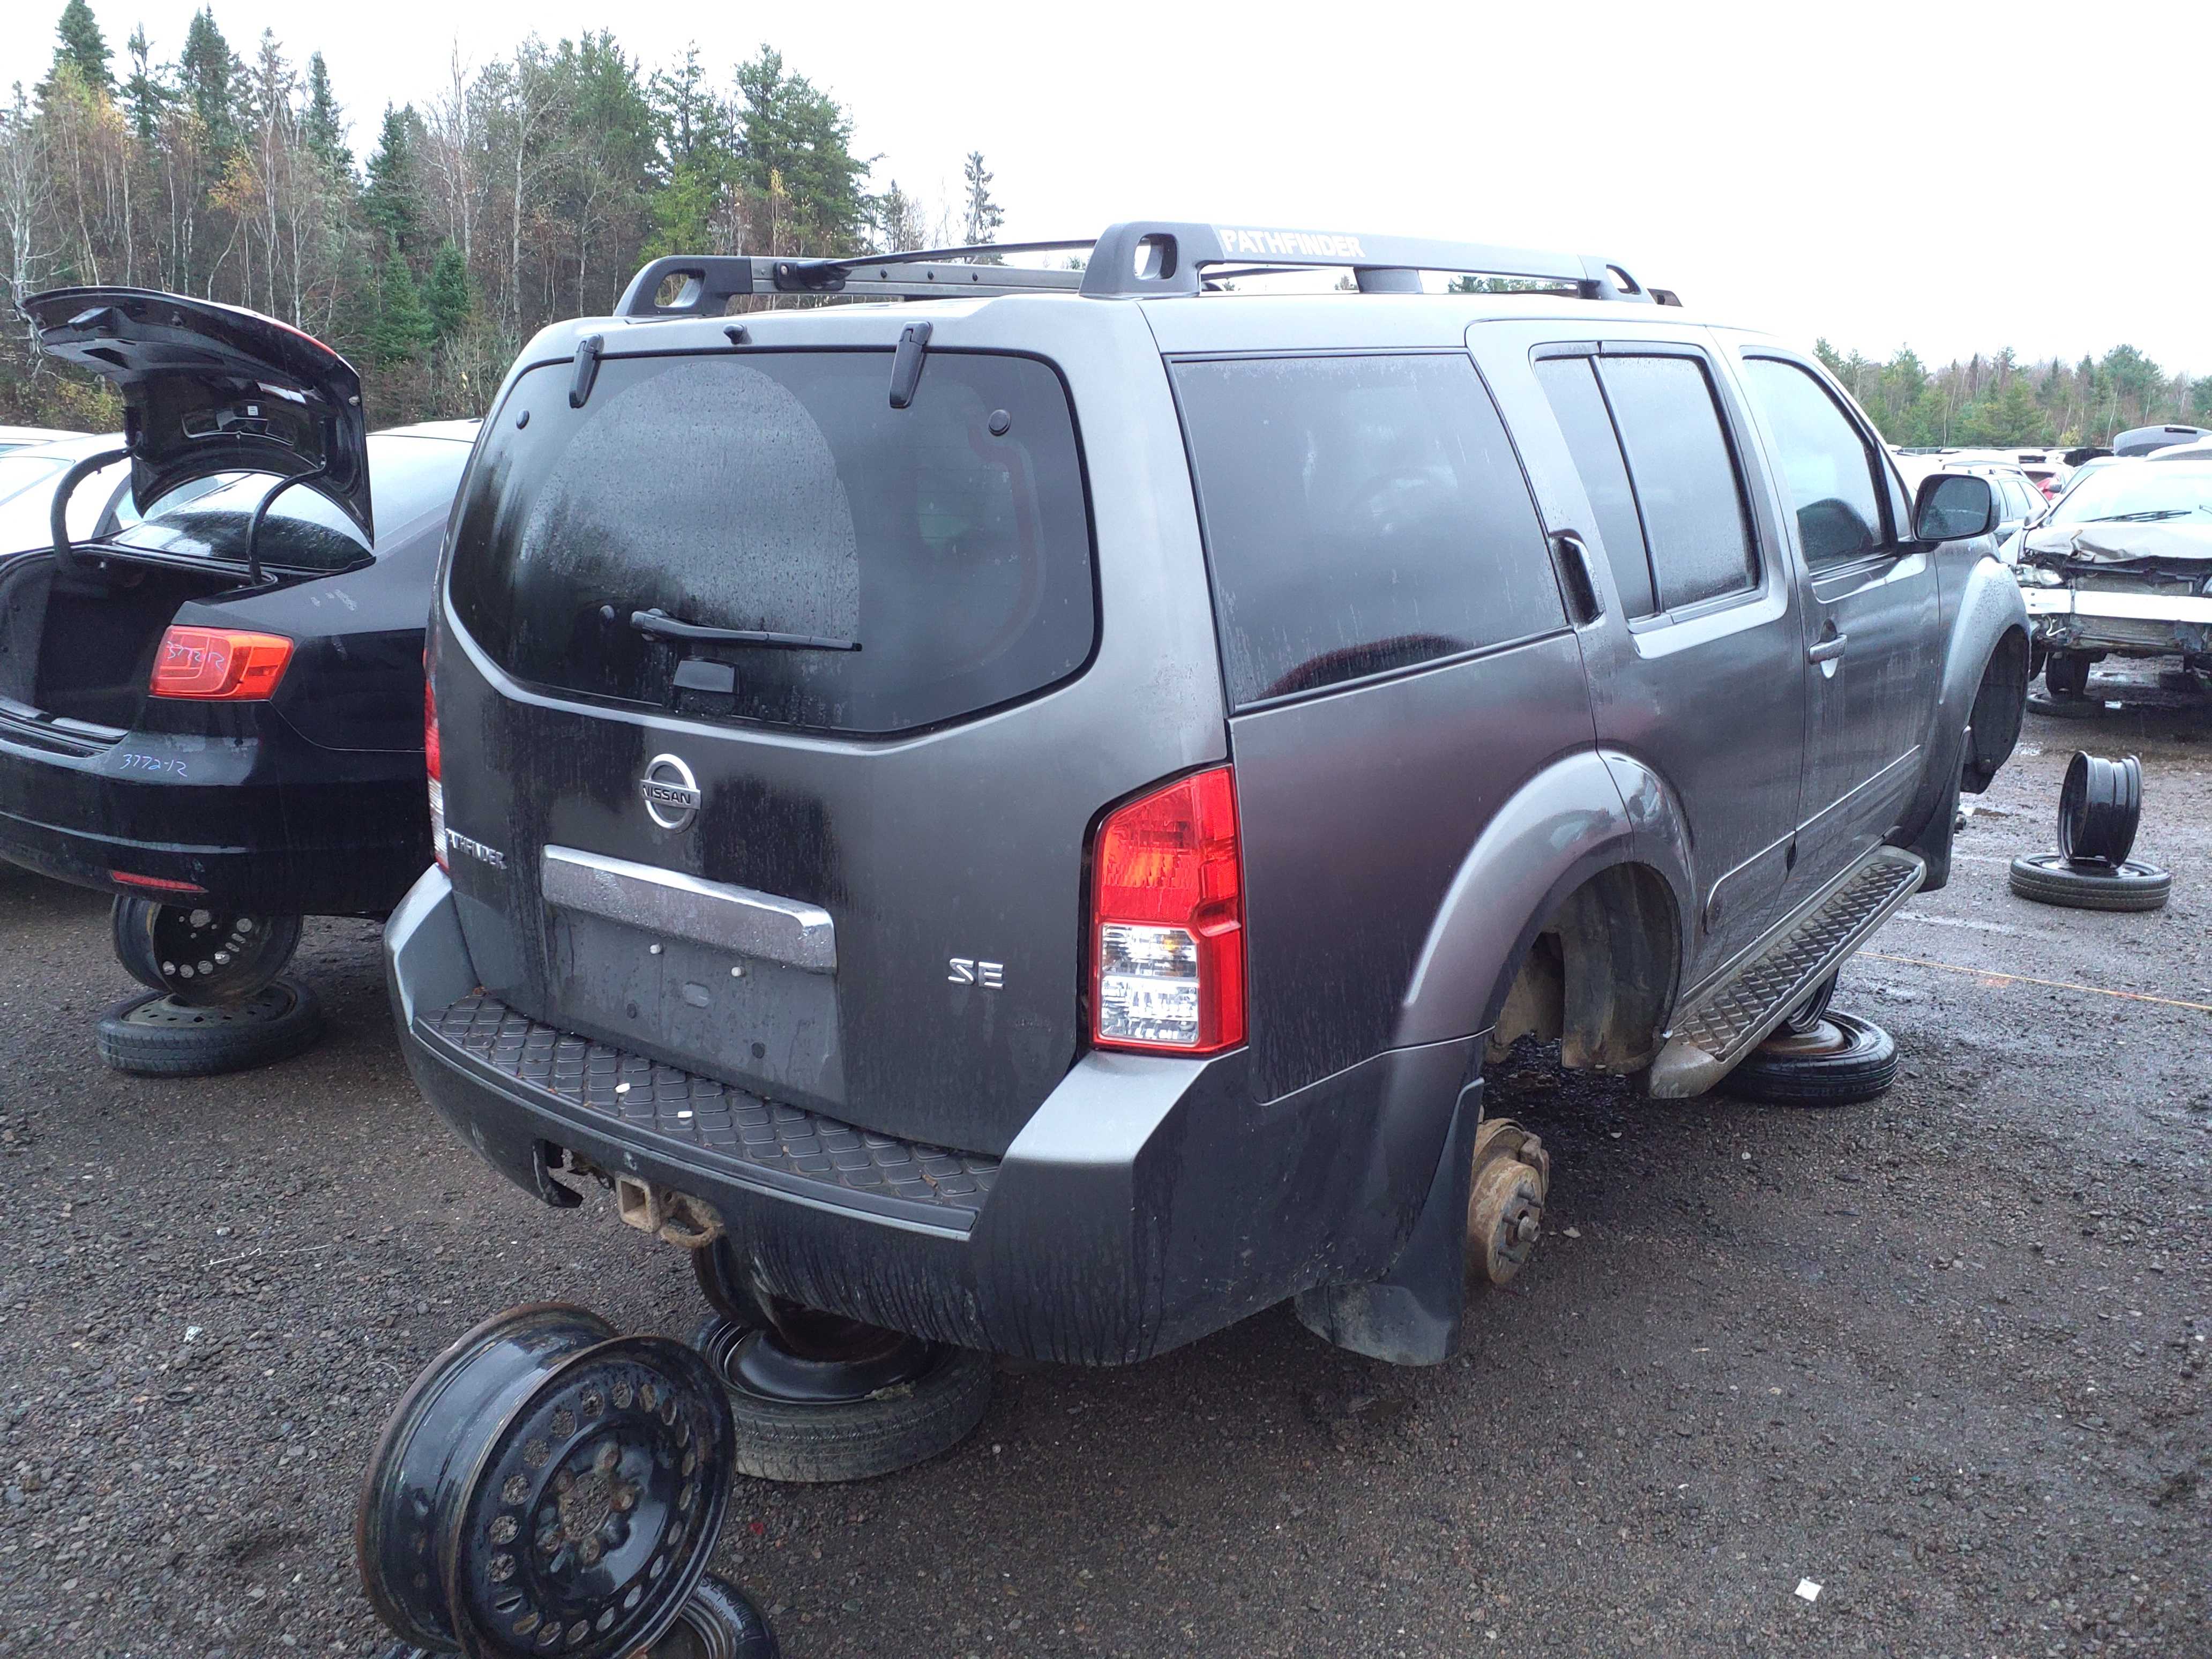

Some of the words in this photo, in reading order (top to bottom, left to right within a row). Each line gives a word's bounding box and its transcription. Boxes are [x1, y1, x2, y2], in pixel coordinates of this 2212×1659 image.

[1219, 229, 1365, 257] PATHFINDER
[119, 753, 188, 777] 3772-12
[642, 784, 691, 804] NISSAN
[947, 958, 1004, 990] SE
